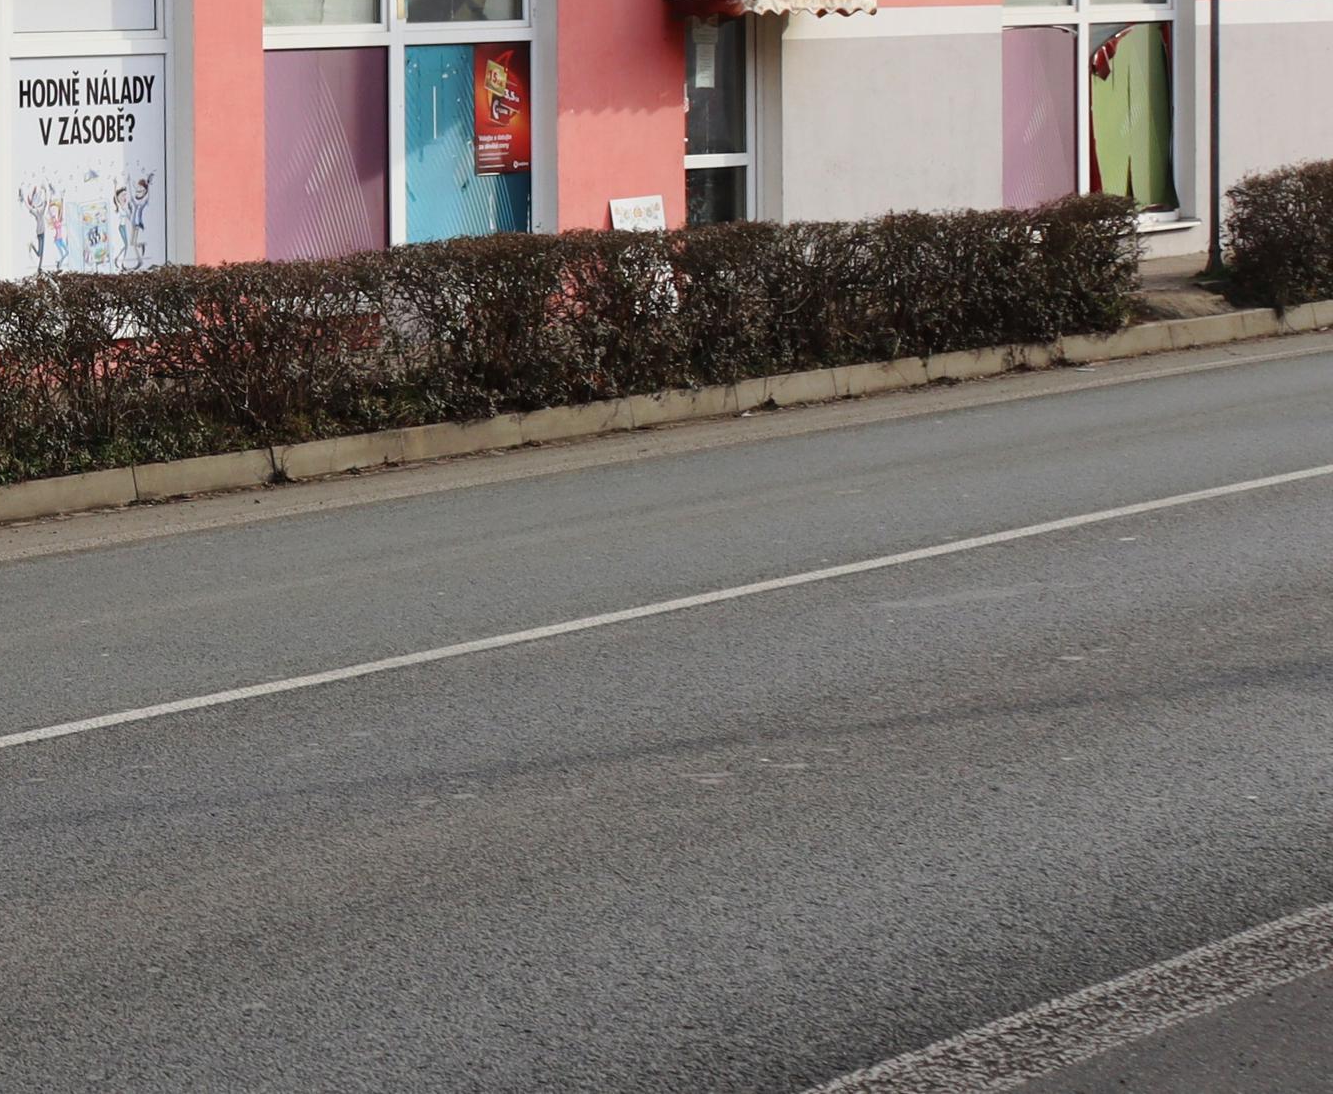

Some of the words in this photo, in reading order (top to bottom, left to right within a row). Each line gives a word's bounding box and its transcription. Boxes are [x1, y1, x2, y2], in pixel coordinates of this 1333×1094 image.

[19, 70, 80, 108] HODNĚ
[86, 69, 155, 106] NÁLADY
[39, 117, 52, 146] V
[58, 107, 136, 145] ZÁSOBĚ?
